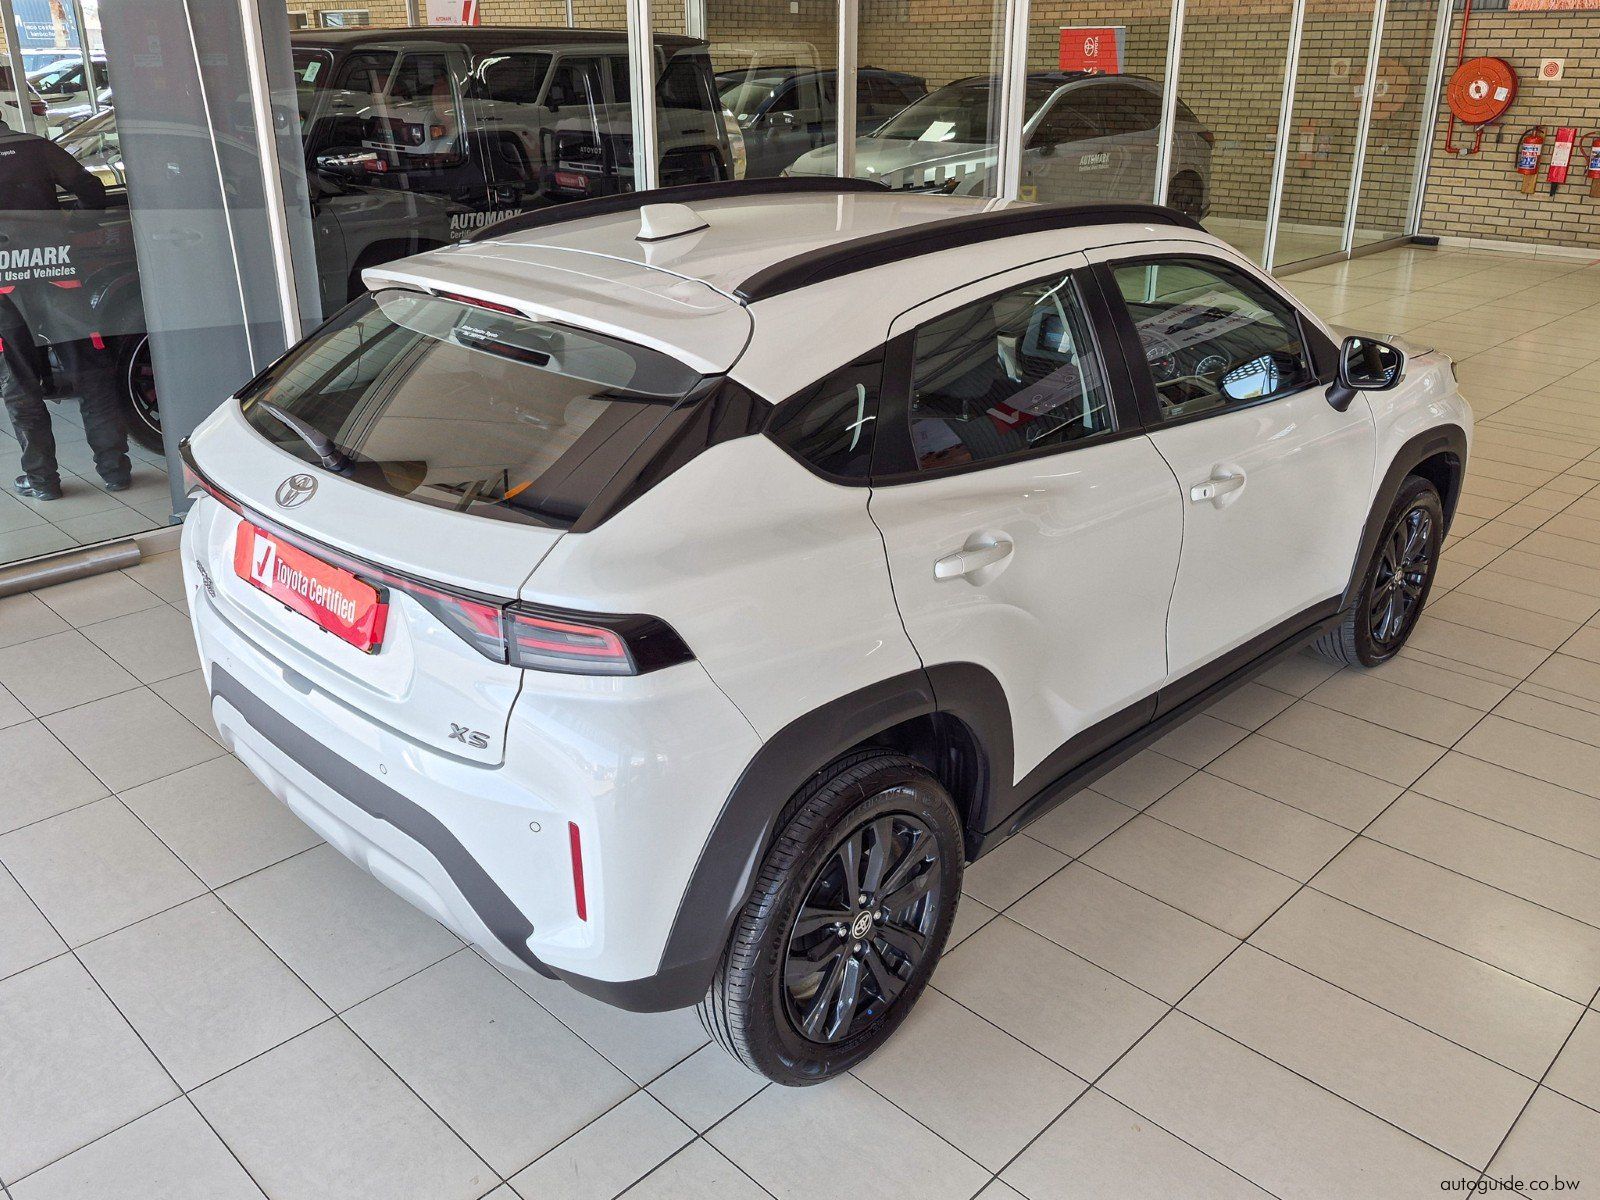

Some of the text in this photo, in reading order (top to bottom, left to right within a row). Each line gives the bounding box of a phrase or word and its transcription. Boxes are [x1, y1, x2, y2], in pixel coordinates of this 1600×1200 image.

[5, 269, 31, 281] Used
[33, 266, 76, 278] Vehicles
[276, 558, 357, 623] Toyota Certified
[448, 722, 490, 749] XS
